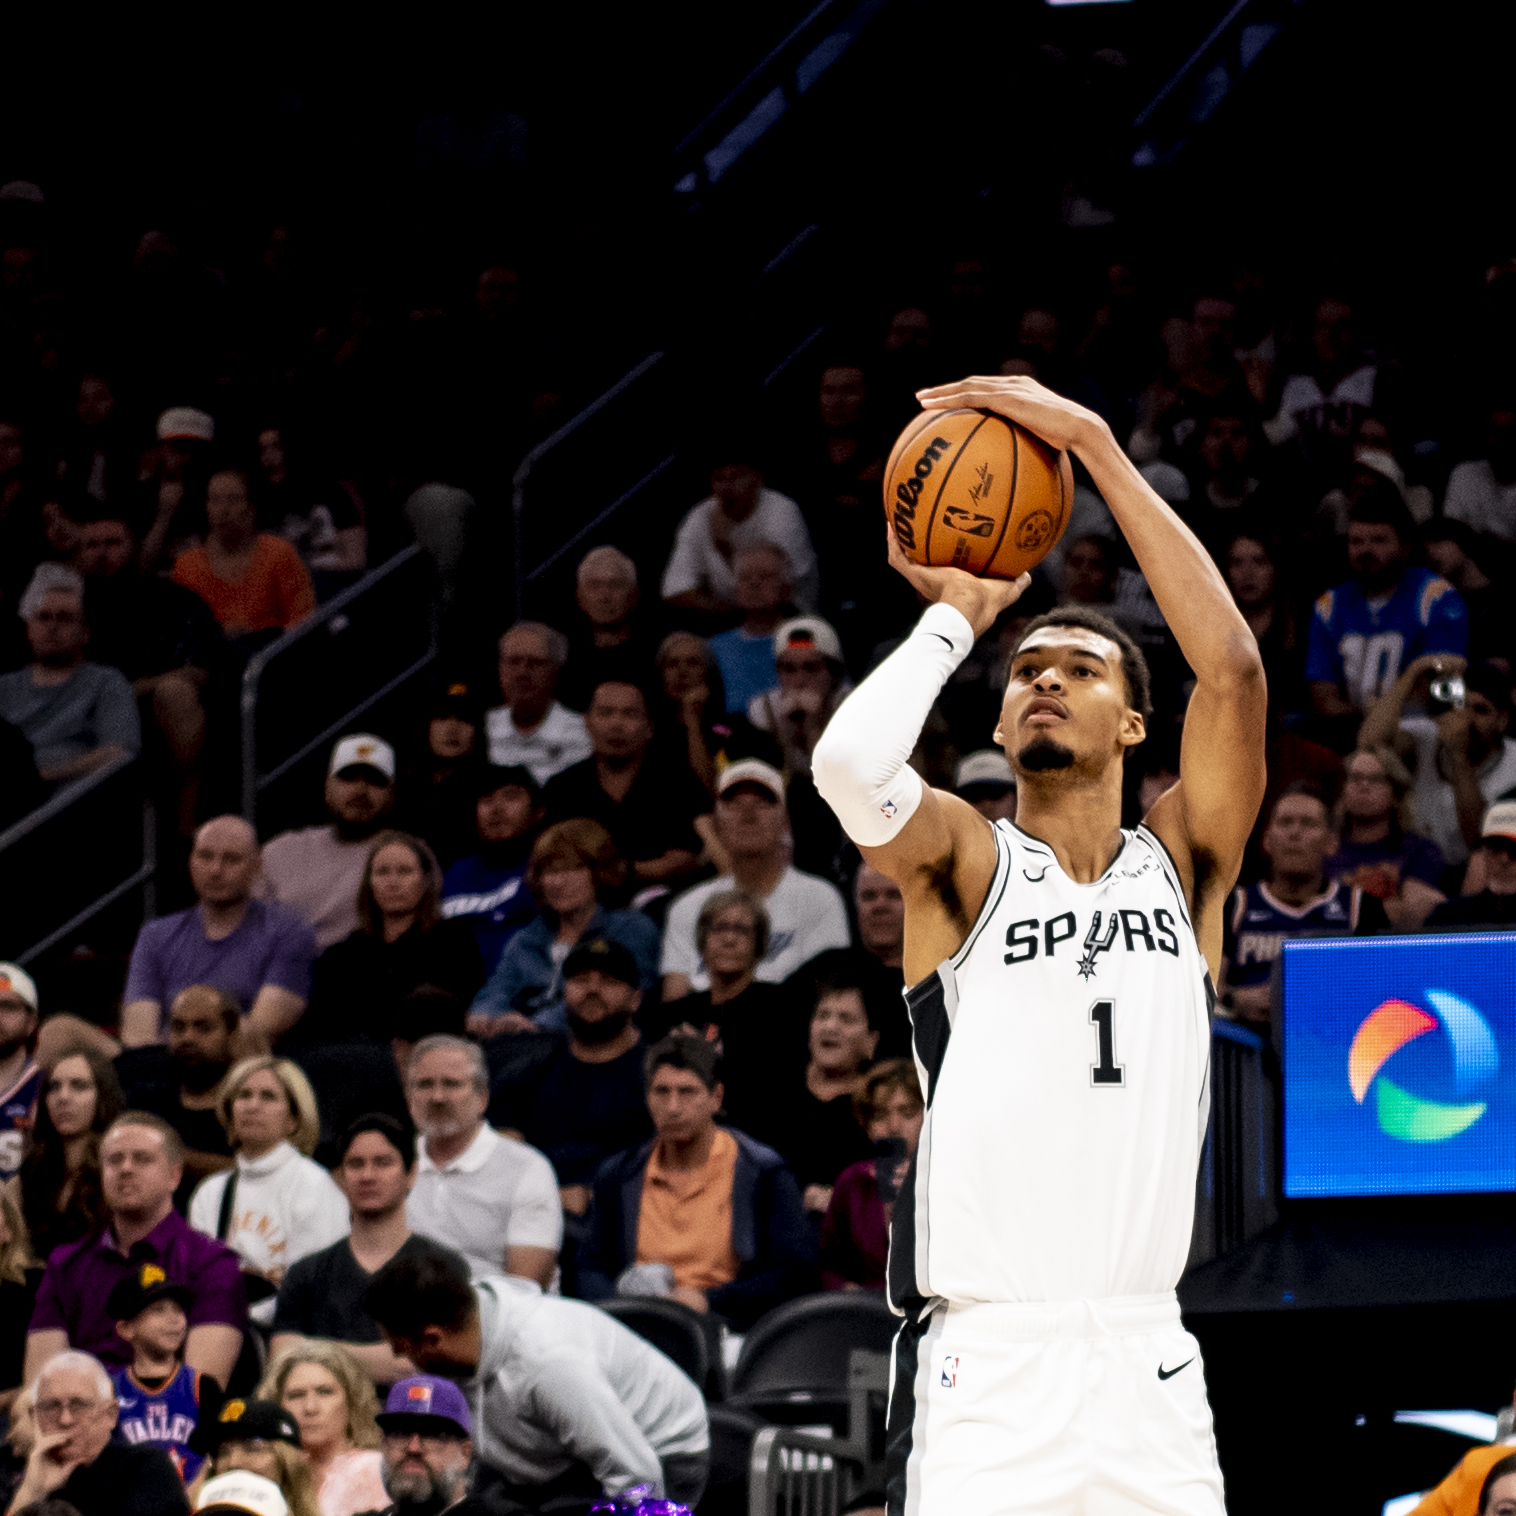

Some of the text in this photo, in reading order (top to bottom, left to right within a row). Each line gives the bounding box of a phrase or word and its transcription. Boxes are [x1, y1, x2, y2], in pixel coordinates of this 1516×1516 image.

[894, 434, 953, 553] Wilson
[1003, 908, 1180, 977] SPURS
[1087, 997, 1126, 1088] 1
